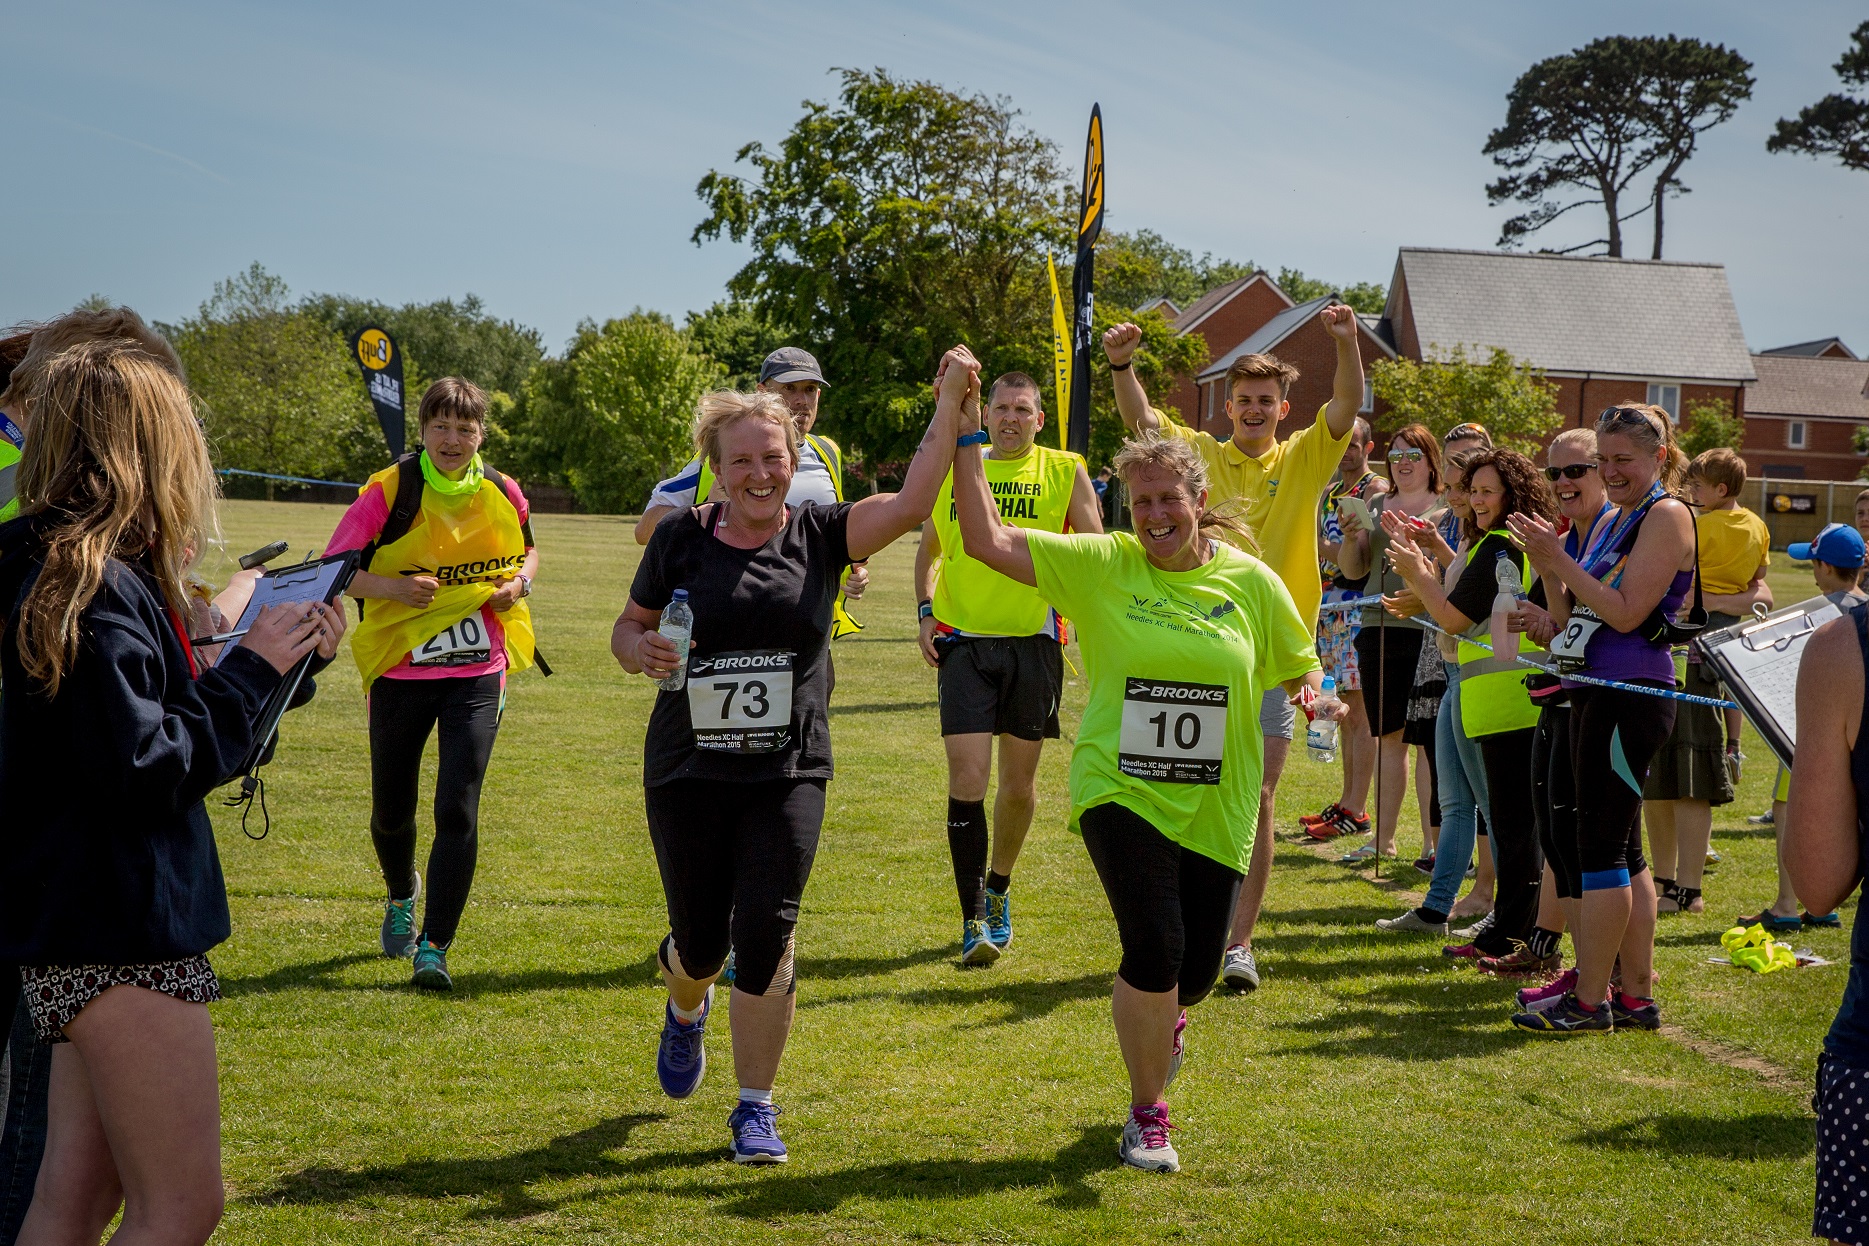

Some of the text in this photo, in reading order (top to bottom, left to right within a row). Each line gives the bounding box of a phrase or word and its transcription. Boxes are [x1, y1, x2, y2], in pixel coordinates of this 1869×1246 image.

[950, 497, 1038, 522] MHAL
[436, 555, 526, 579] BROOKS
[1572, 606, 1601, 619] BROOK
[421, 617, 480, 654] 210
[1126, 612, 1238, 643] Needles XC Half Marathon 2014
[714, 655, 788, 670] BROOKS
[713, 680, 770, 719] 73
[1150, 686, 1225, 701] BROOKS
[1149, 711, 1202, 750] 10
[1121, 759, 1147, 768] Needles
[1121, 766, 1151, 776] Marathon
